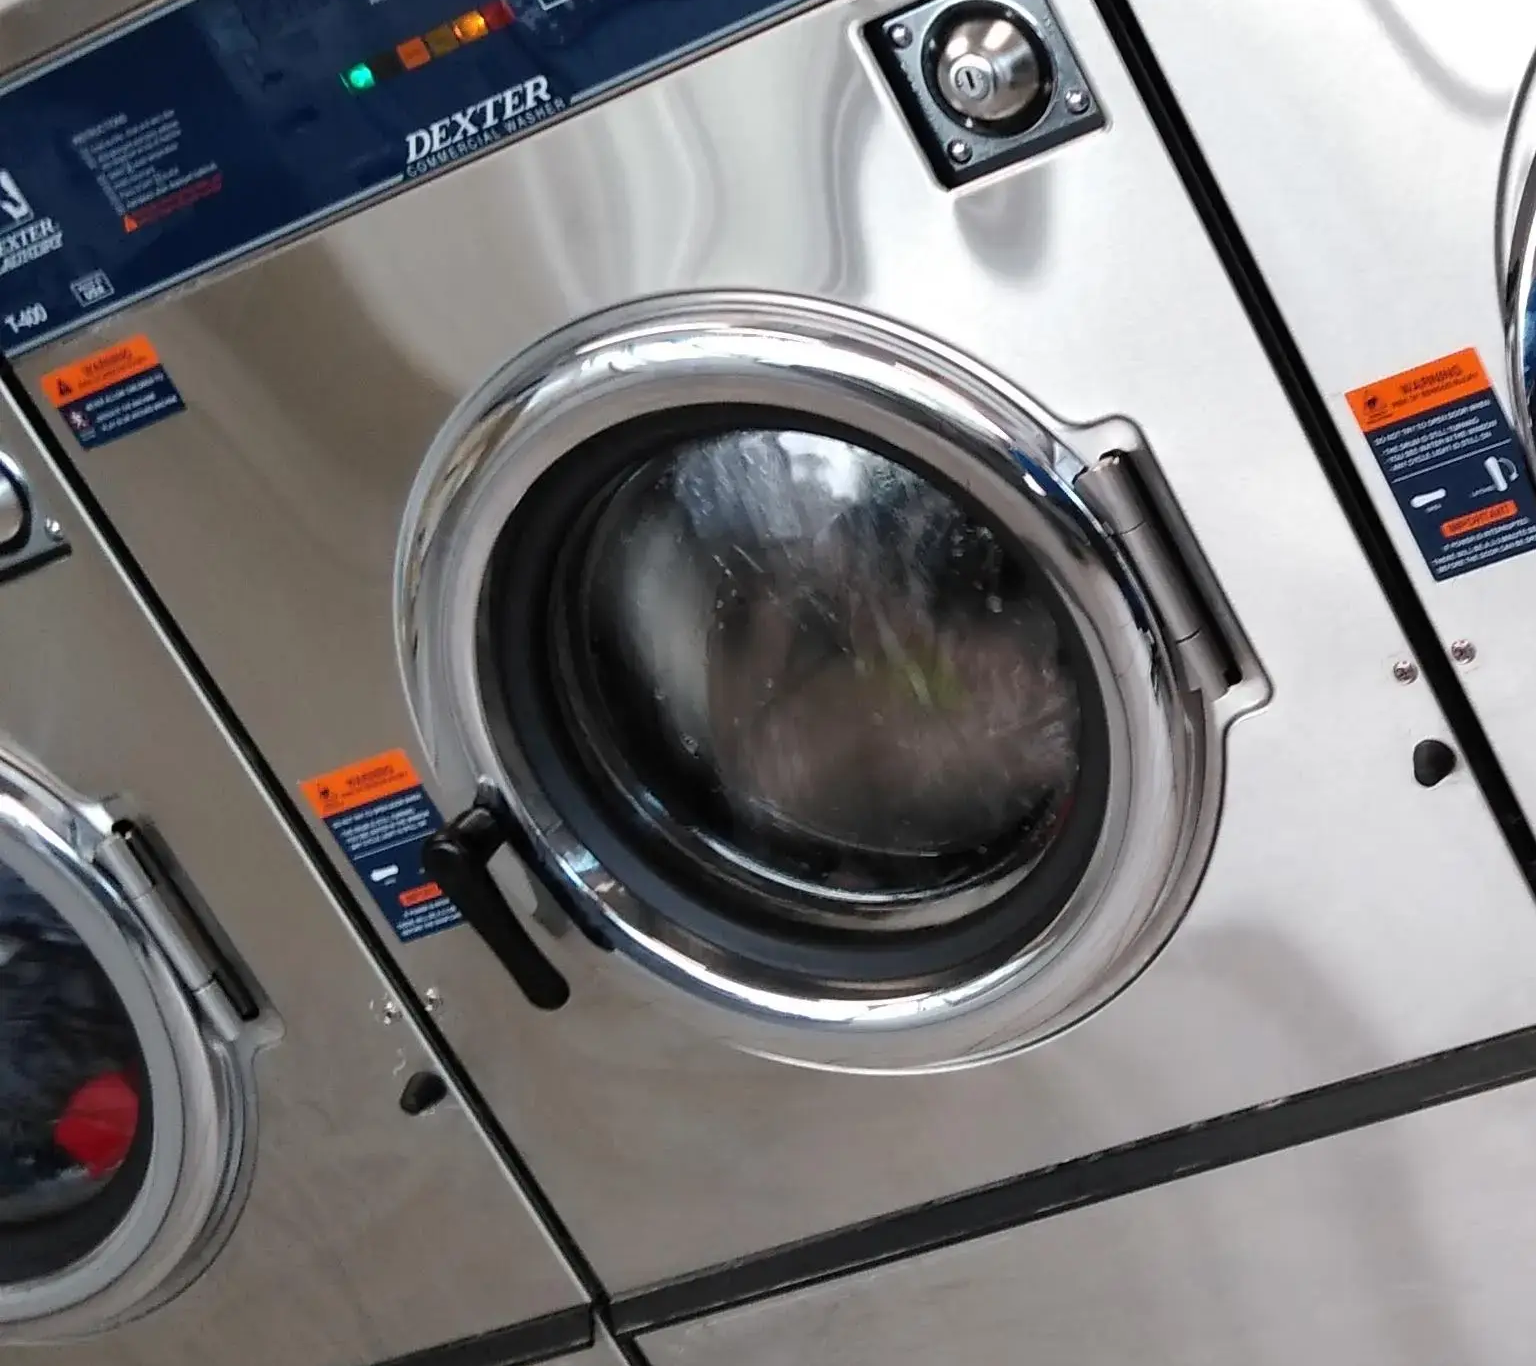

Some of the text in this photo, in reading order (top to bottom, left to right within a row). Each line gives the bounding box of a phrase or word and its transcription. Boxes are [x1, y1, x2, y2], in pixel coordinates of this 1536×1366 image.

[405, 74, 552, 164] DEXTER
[406, 96, 566, 178] COMMERCIAL WASHER
[1400, 364, 1464, 395] WARNING
